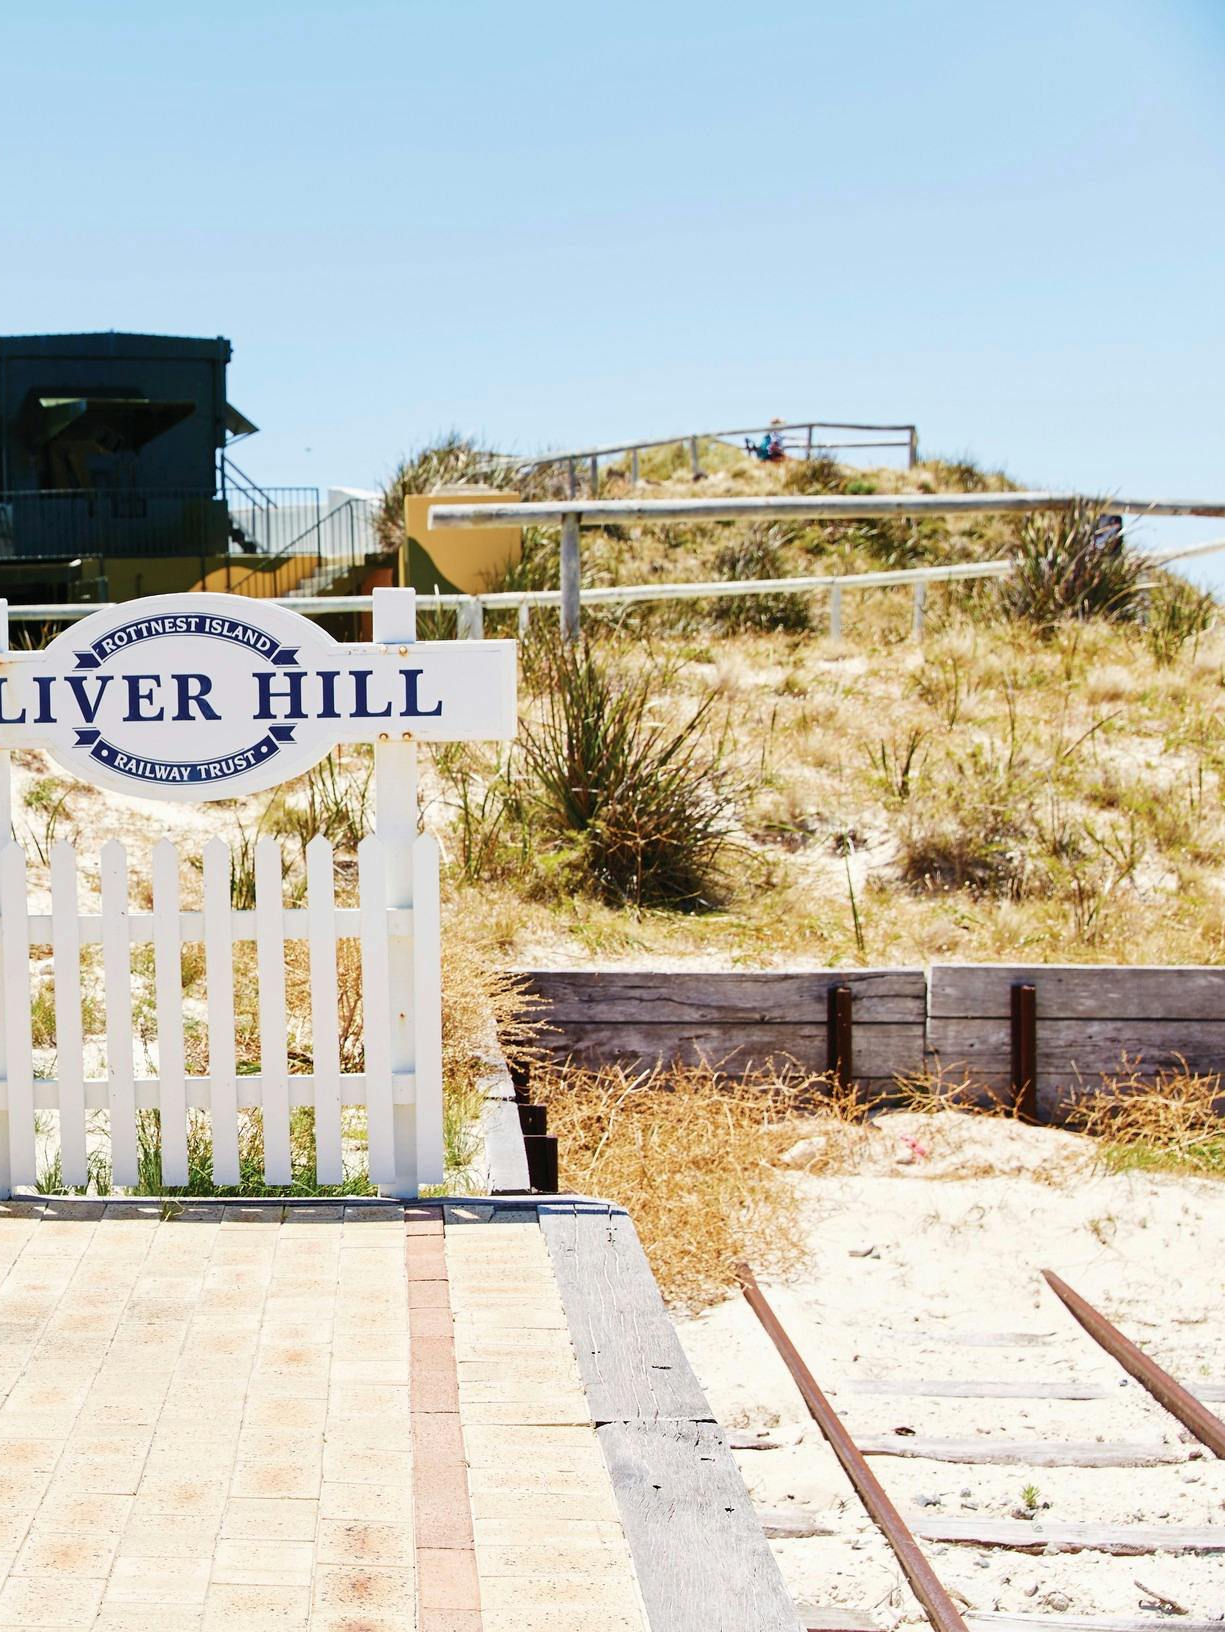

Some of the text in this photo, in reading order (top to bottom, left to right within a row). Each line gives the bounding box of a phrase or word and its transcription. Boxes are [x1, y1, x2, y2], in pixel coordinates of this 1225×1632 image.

[101, 617, 271, 654] ROTTNEST ISLAND
[251, 669, 443, 720] HILL
[113, 750, 257, 781] RAILWAY TRUST
